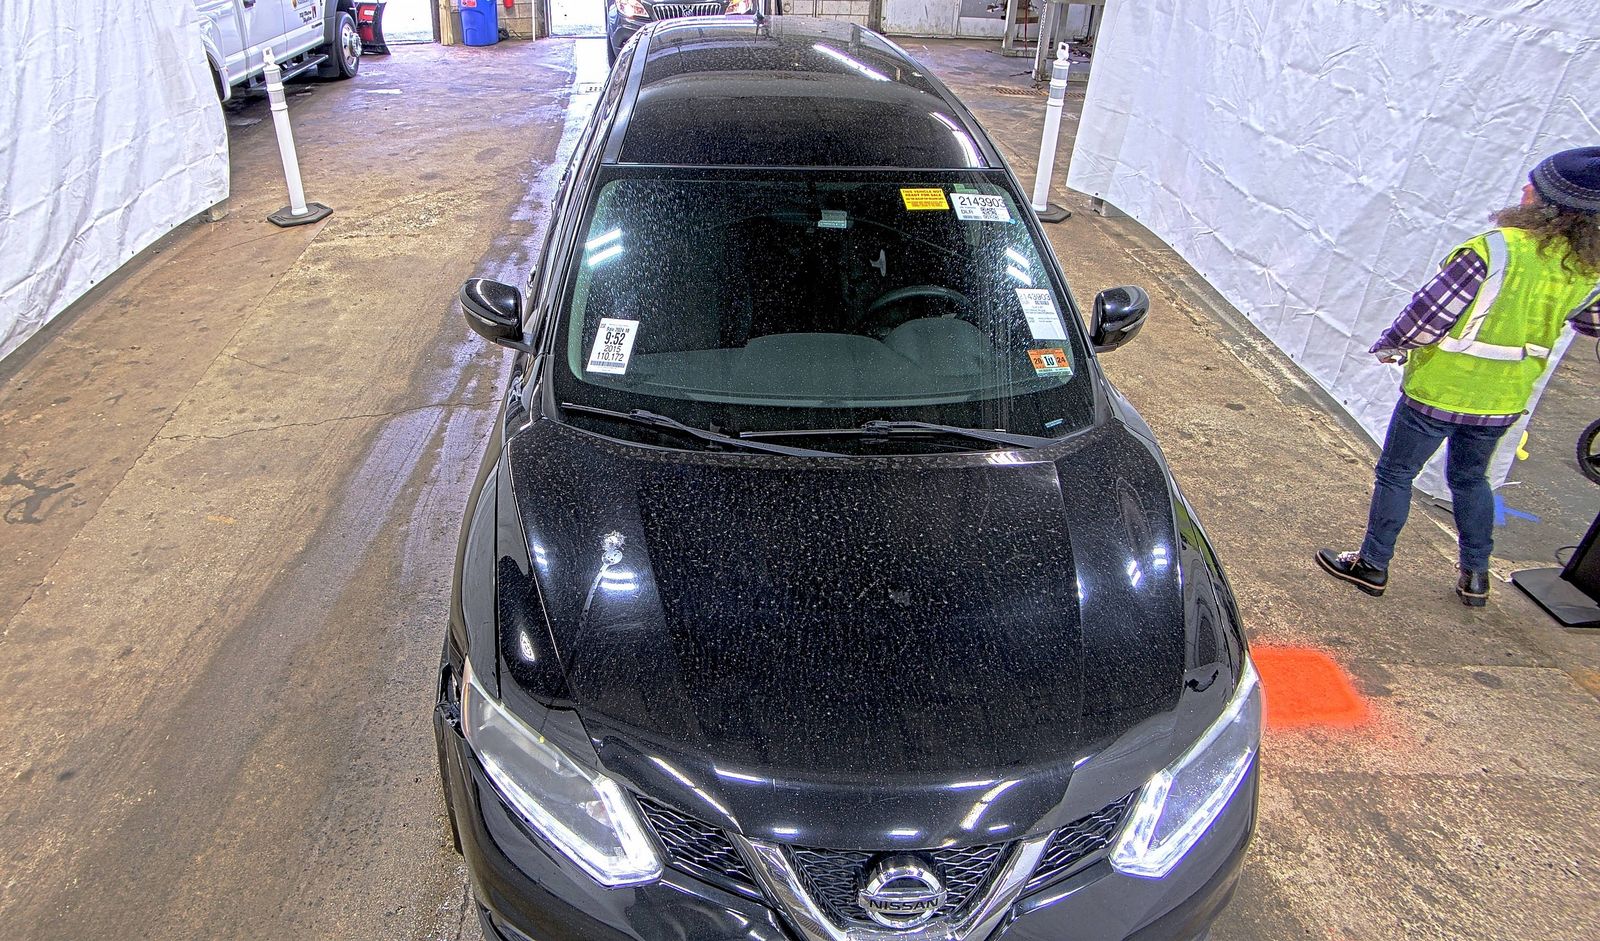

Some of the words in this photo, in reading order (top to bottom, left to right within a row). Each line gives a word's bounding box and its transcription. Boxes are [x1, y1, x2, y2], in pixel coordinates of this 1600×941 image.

[959, 196, 1006, 207] 2143903
[604, 331, 626, 346] 9:52
[604, 345, 622, 353] 2015
[1056, 356, 1066, 364] 24
[869, 898, 939, 910] NISSAN
